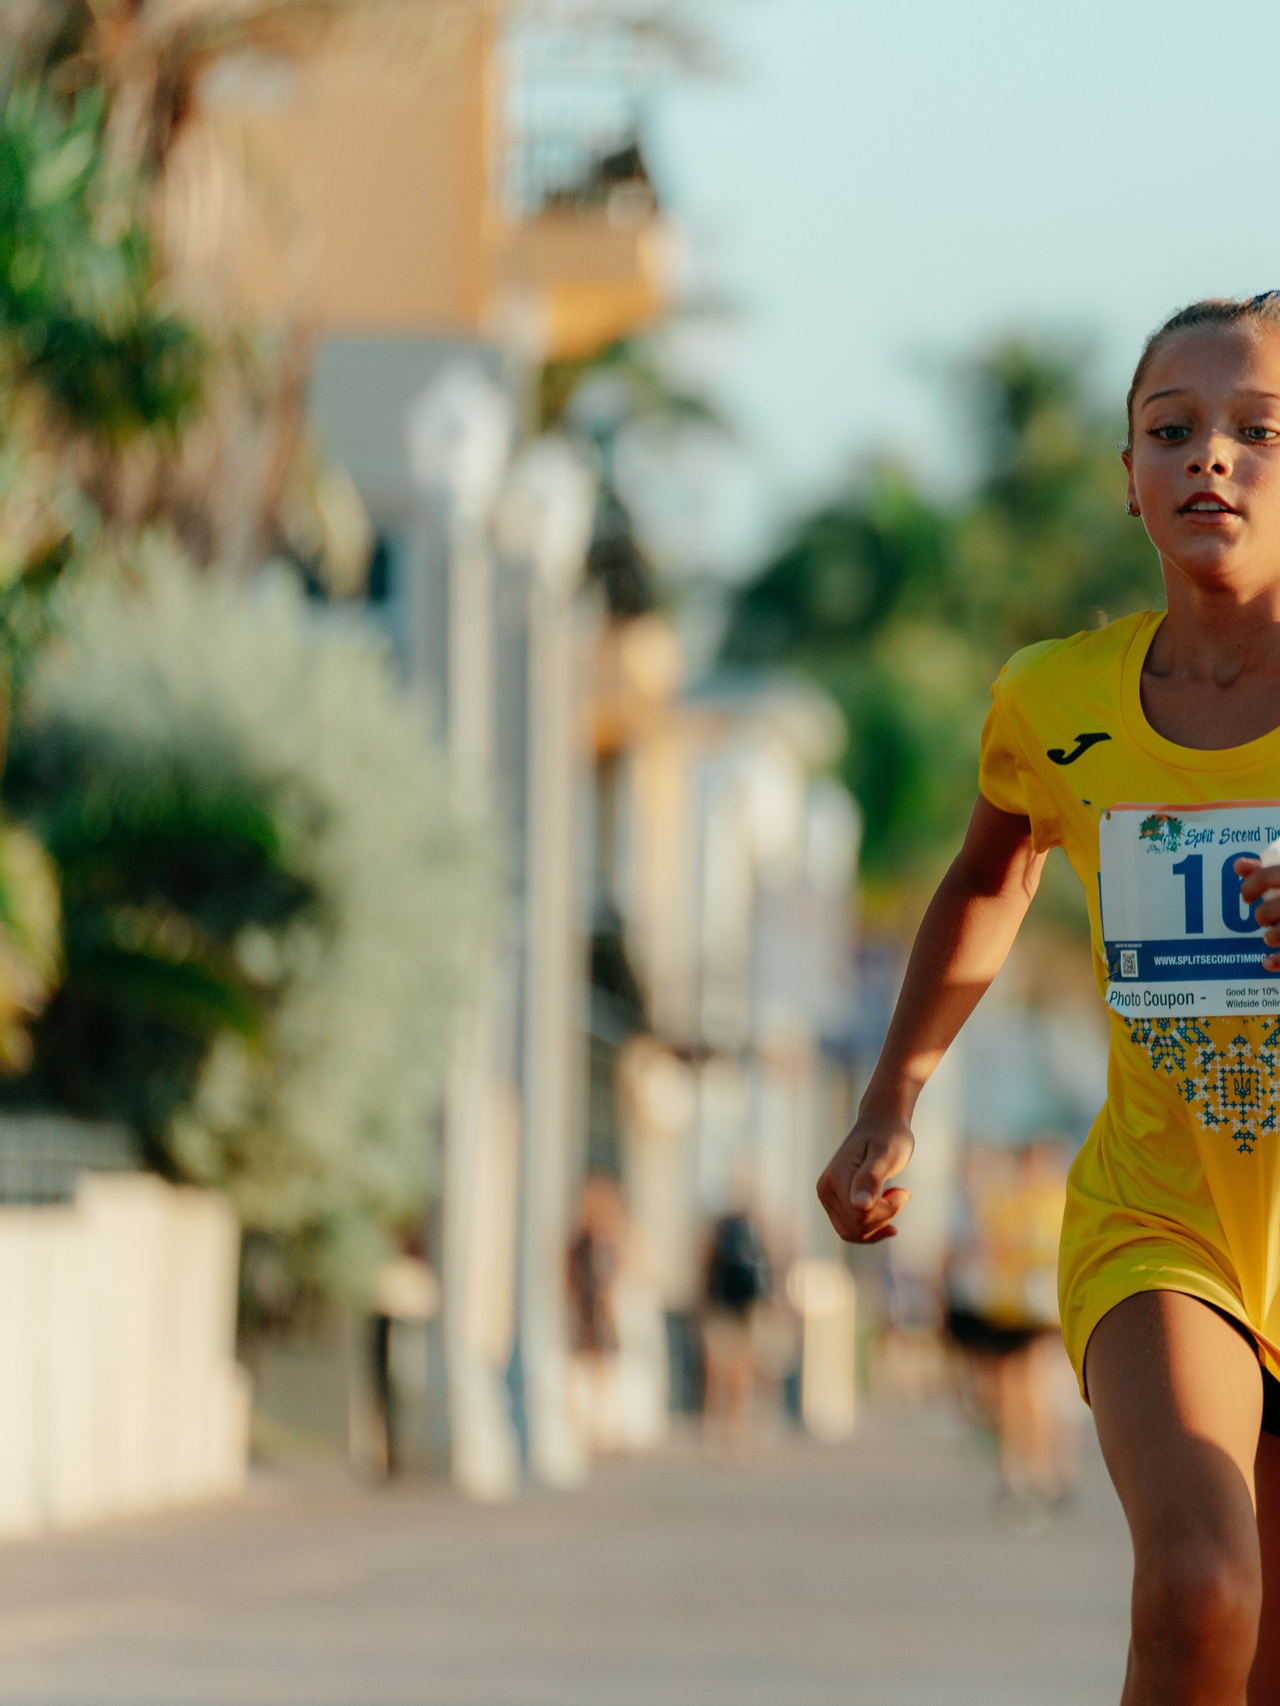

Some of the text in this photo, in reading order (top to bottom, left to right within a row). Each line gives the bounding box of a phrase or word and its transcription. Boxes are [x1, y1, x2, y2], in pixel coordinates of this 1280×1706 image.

[1184, 829, 1215, 848] Split
[1218, 827, 1261, 845] Second
[1225, 988, 1246, 997] Good
[1248, 987, 1259, 996] for
[1261, 987, 1280, 996] 10%
[1109, 990, 1141, 1007] Photo
[1143, 990, 1195, 1009] Coupon
[1225, 1000, 1260, 1008] Wildside
